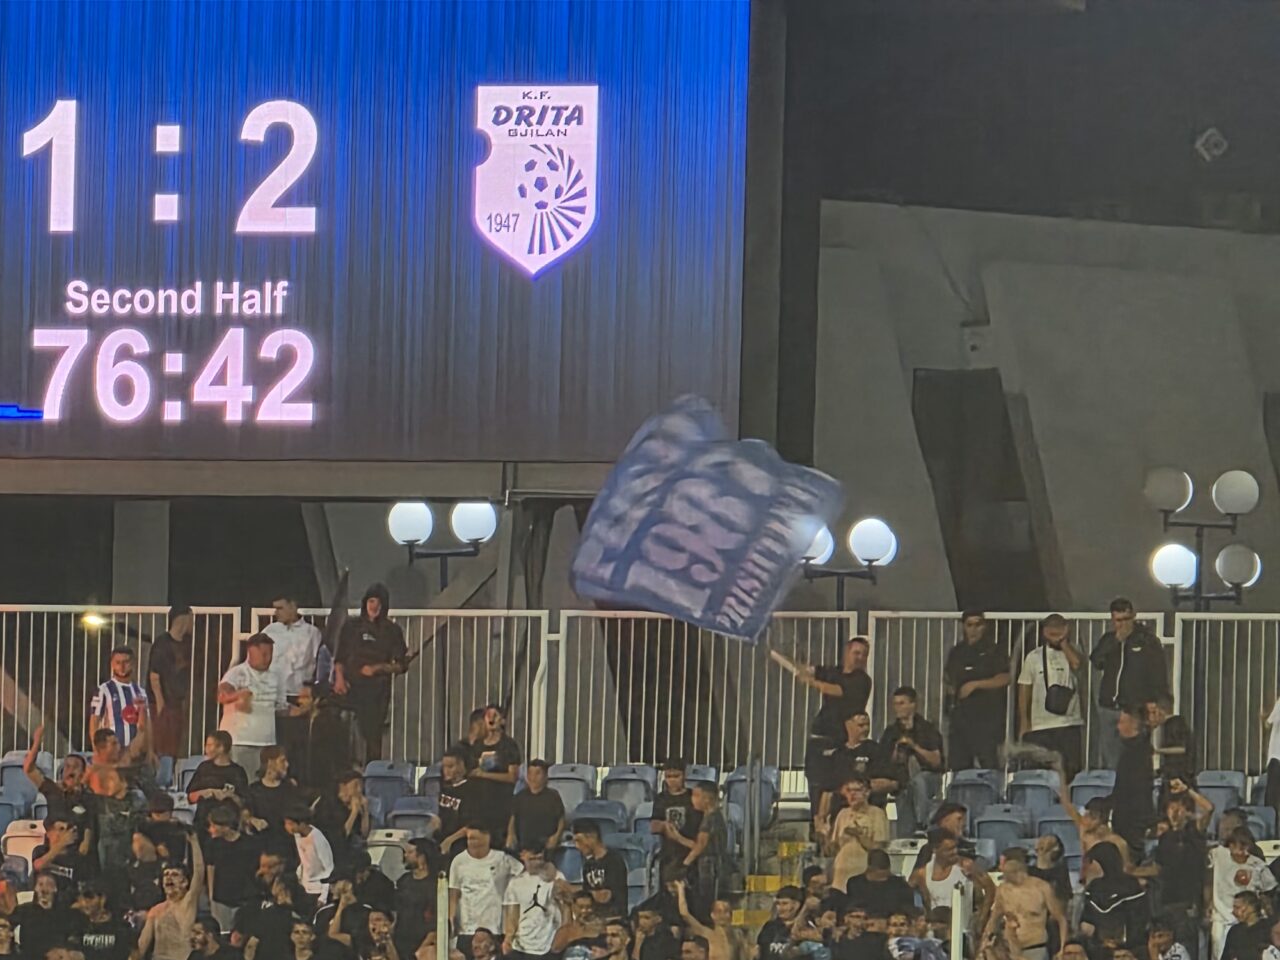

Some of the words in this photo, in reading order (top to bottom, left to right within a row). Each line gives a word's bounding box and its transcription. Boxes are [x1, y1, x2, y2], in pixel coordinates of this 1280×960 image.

[522, 90, 551, 99] K.F.
[491, 105, 584, 127] DRITA
[508, 128, 567, 137] GJILAN
[22, 99, 77, 232] 1
[235, 99, 318, 232] 2
[486, 213, 520, 232] 1947
[65, 280, 202, 314] Second
[216, 280, 288, 314] Half
[32, 327, 315, 421] 76:42
